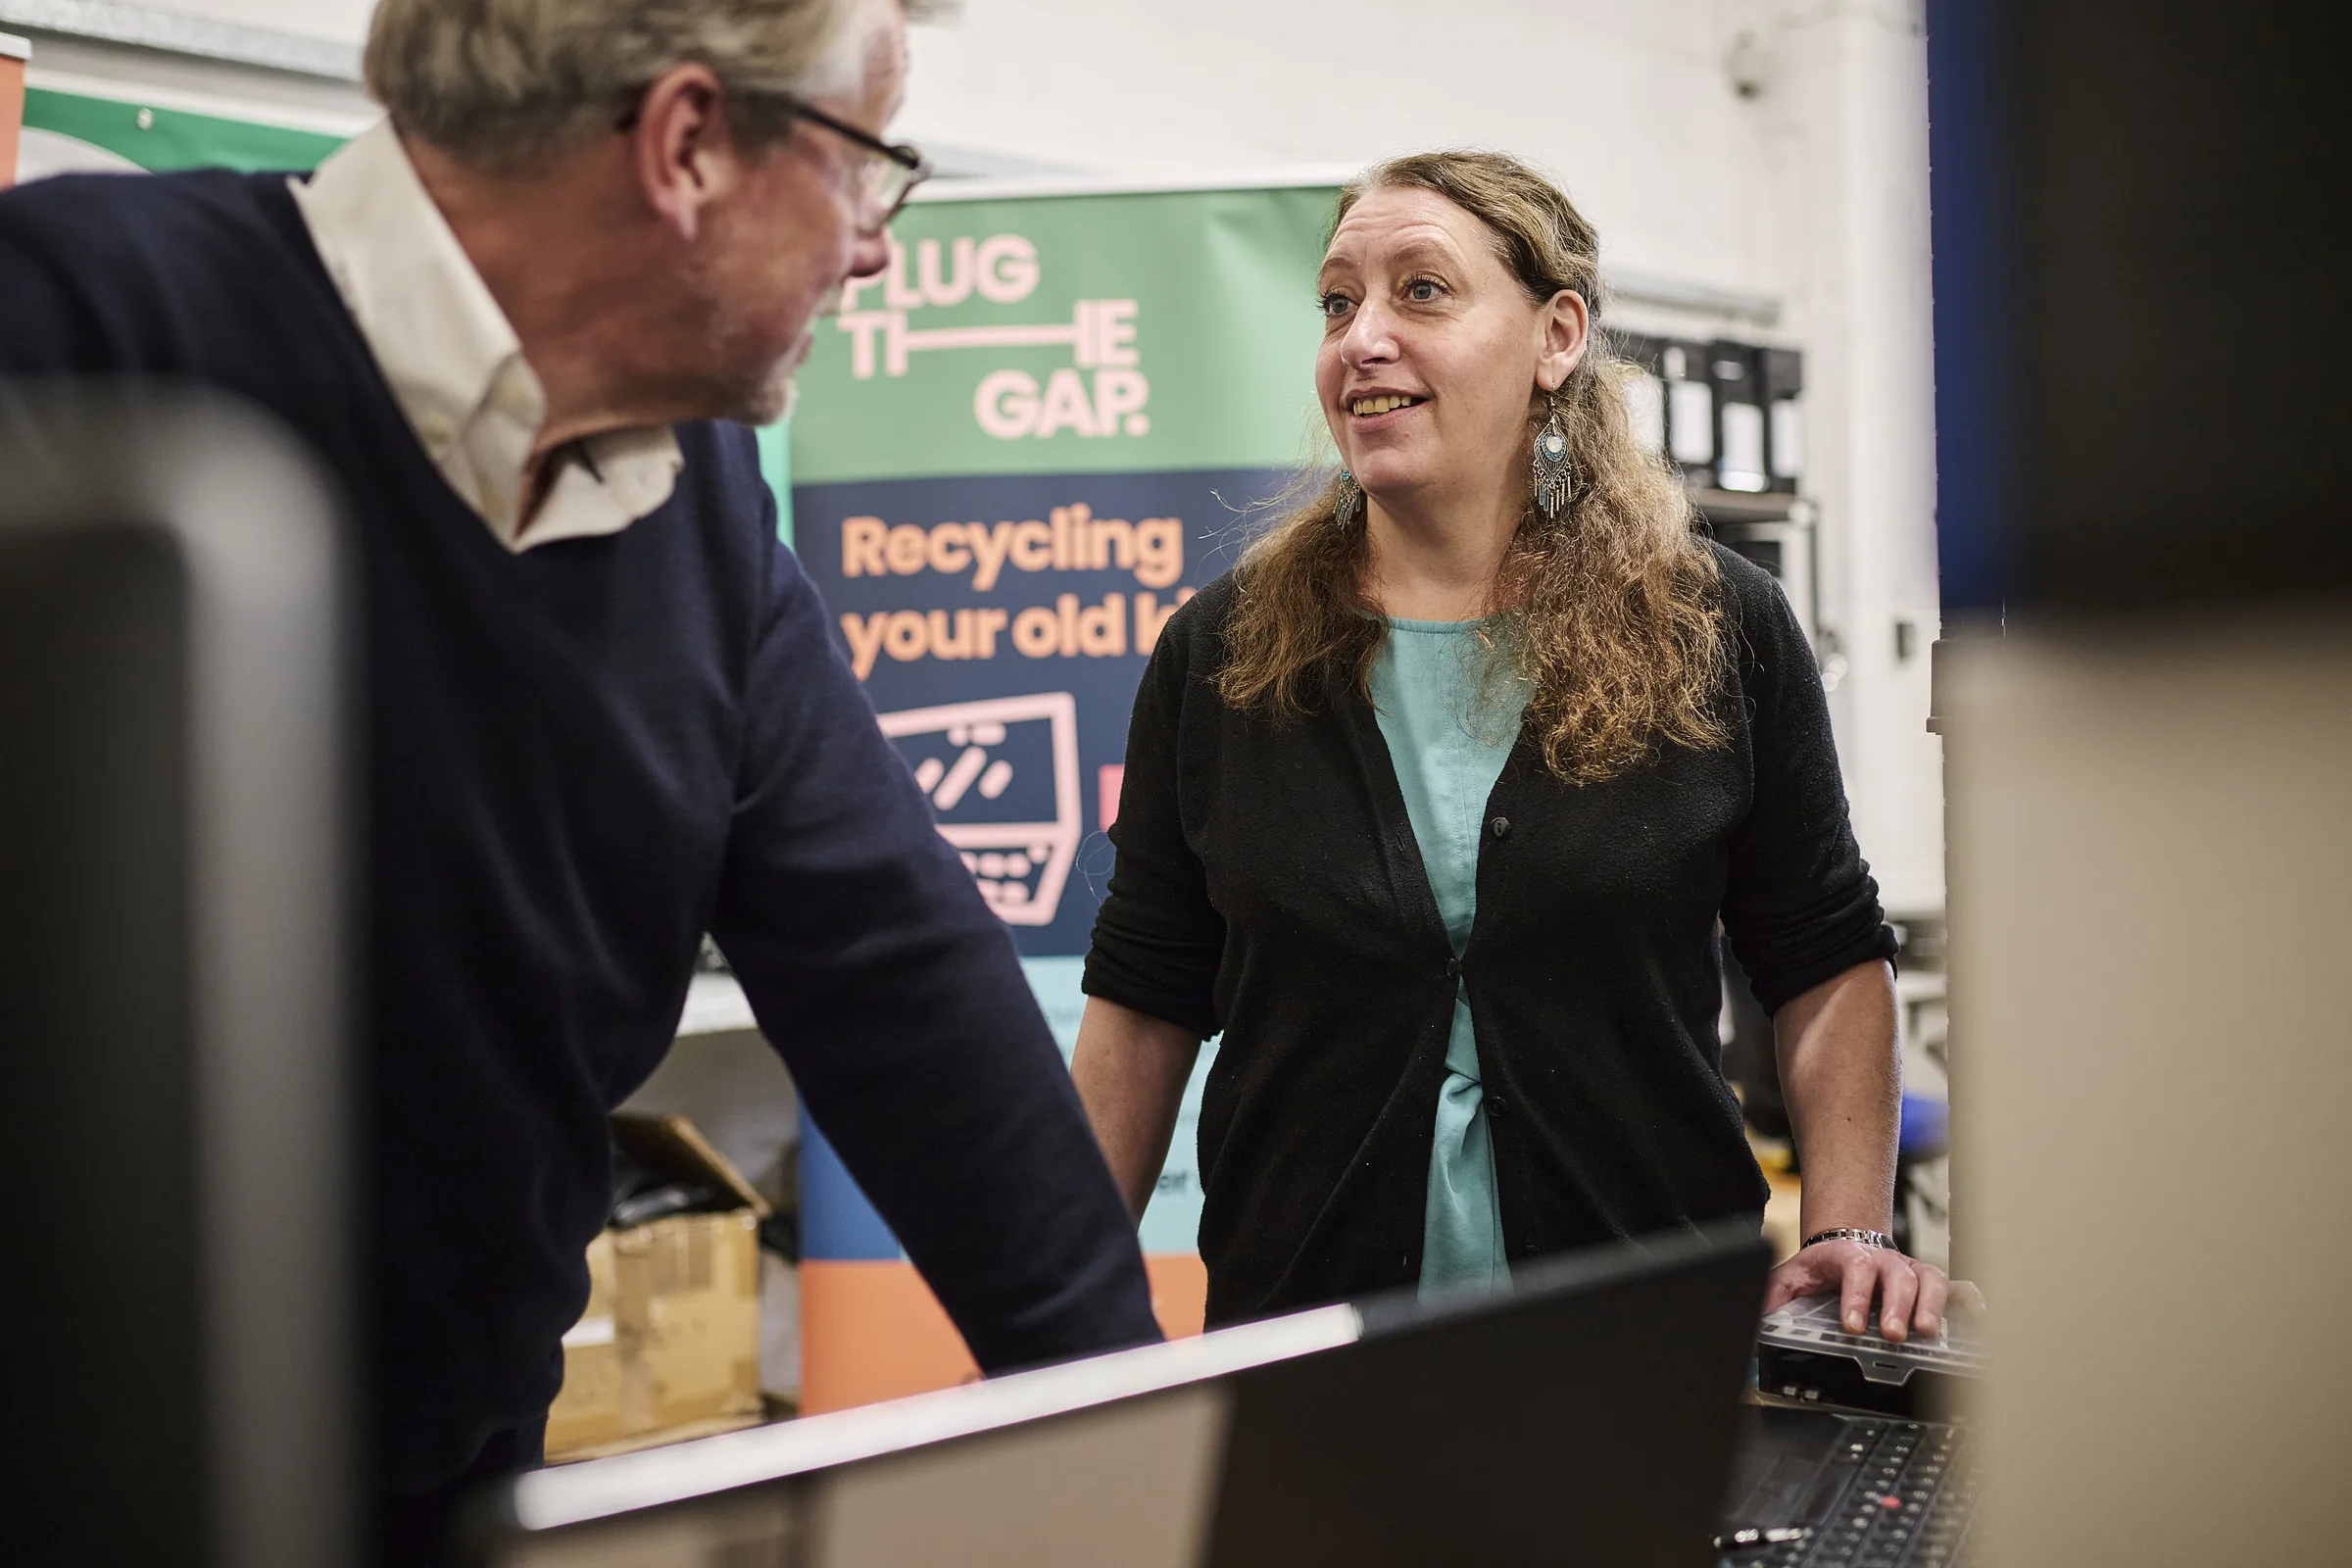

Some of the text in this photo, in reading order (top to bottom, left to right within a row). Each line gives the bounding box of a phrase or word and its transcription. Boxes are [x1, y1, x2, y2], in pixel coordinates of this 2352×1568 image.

[838, 300, 1139, 378] THE
[974, 368, 1151, 439] GAP.
[841, 502, 1184, 590] Recycling
[840, 605, 1006, 682] your
[1012, 593, 1126, 658] old
